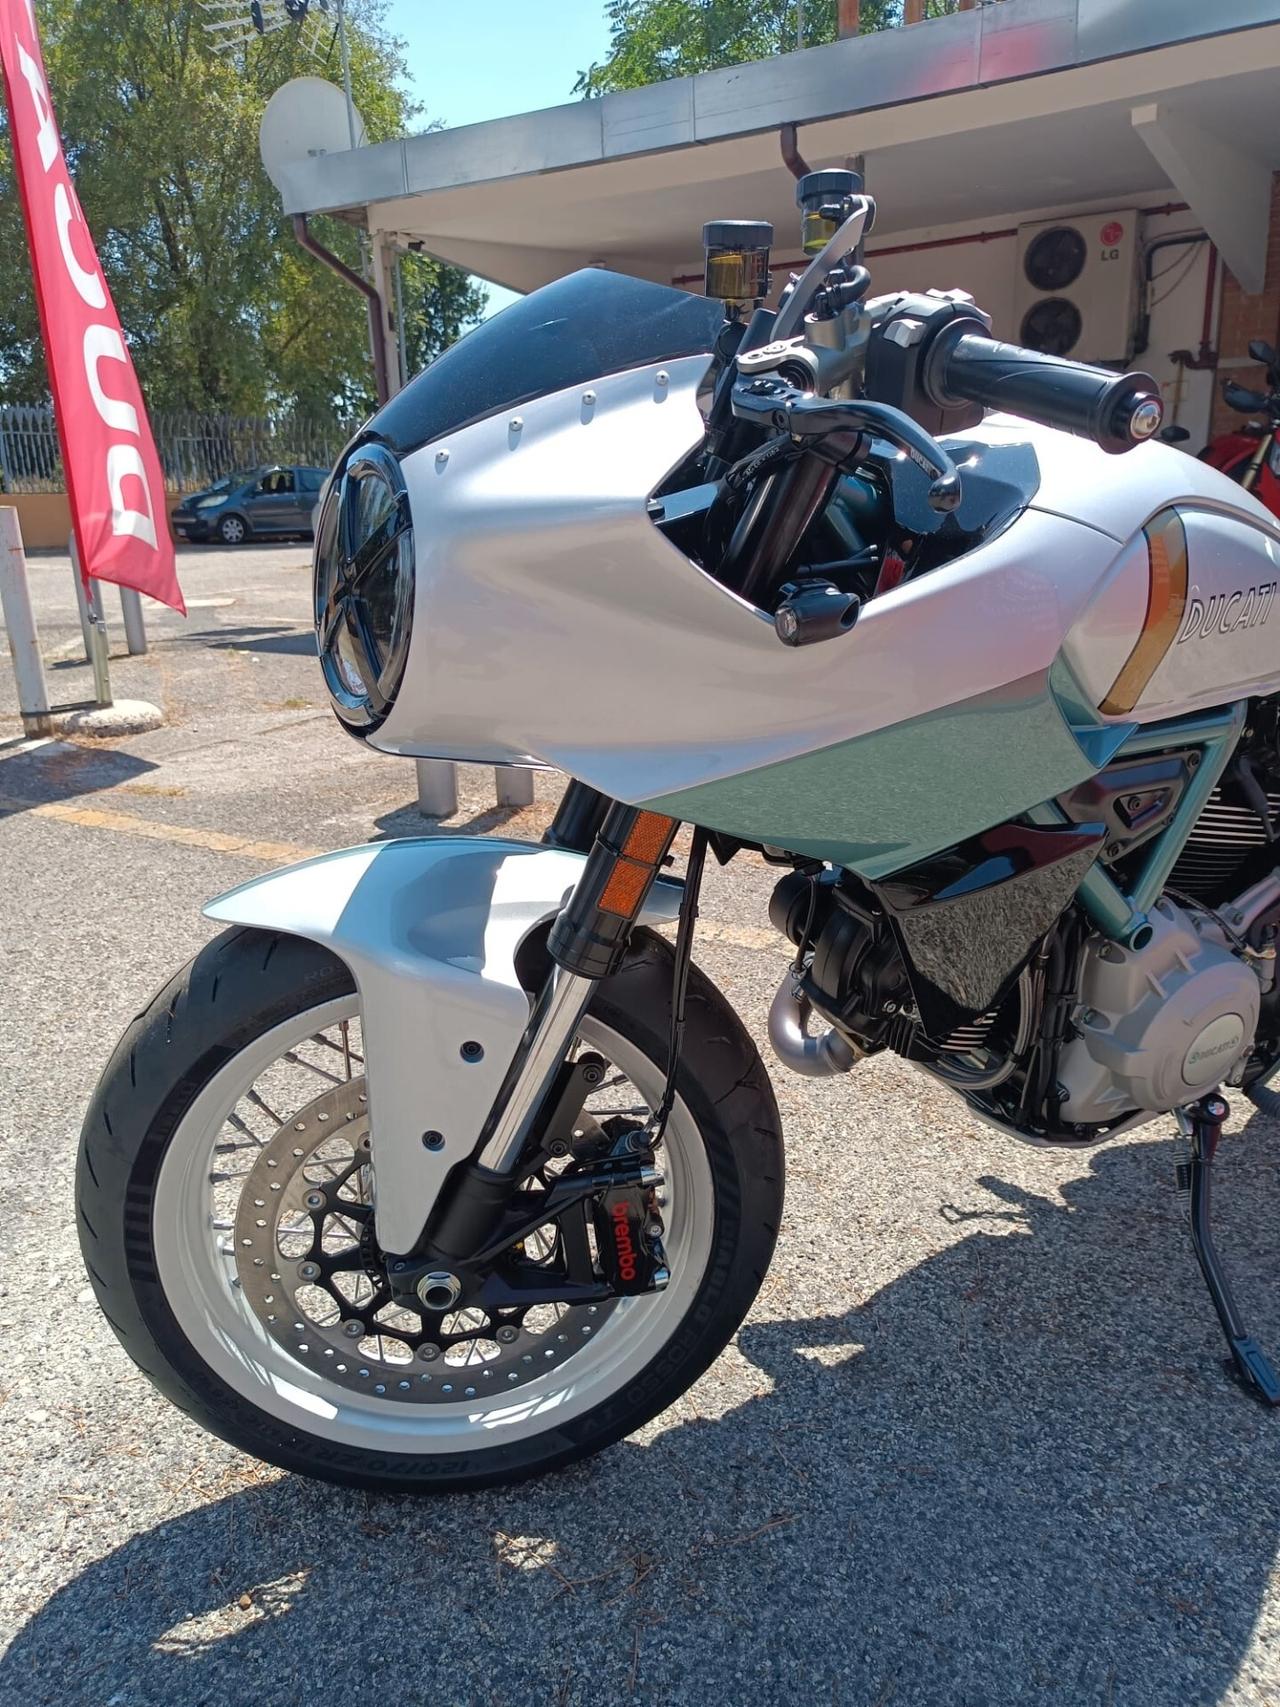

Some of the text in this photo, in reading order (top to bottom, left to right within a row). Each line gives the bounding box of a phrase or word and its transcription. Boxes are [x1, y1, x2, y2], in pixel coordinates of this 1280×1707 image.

[1101, 249, 1119, 261] LG
[1176, 581, 1278, 645] DUCATI
[611, 1201, 638, 1281] brembo
